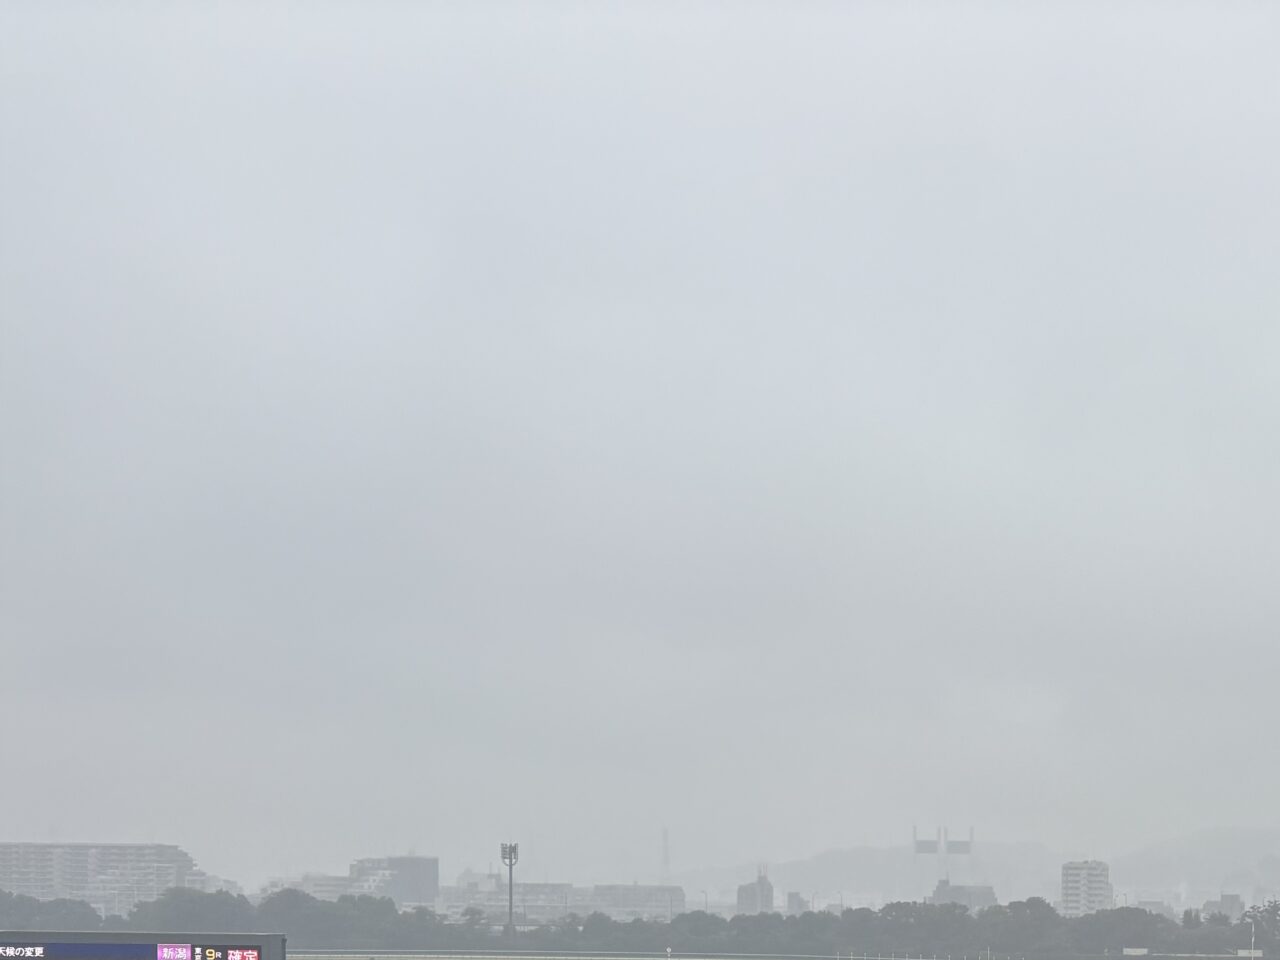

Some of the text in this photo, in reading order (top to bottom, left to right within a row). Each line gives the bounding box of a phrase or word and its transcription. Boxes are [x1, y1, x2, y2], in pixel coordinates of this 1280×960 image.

[0, 947, 44, 957] 天候の変更
[162, 947, 187, 960] 新潟
